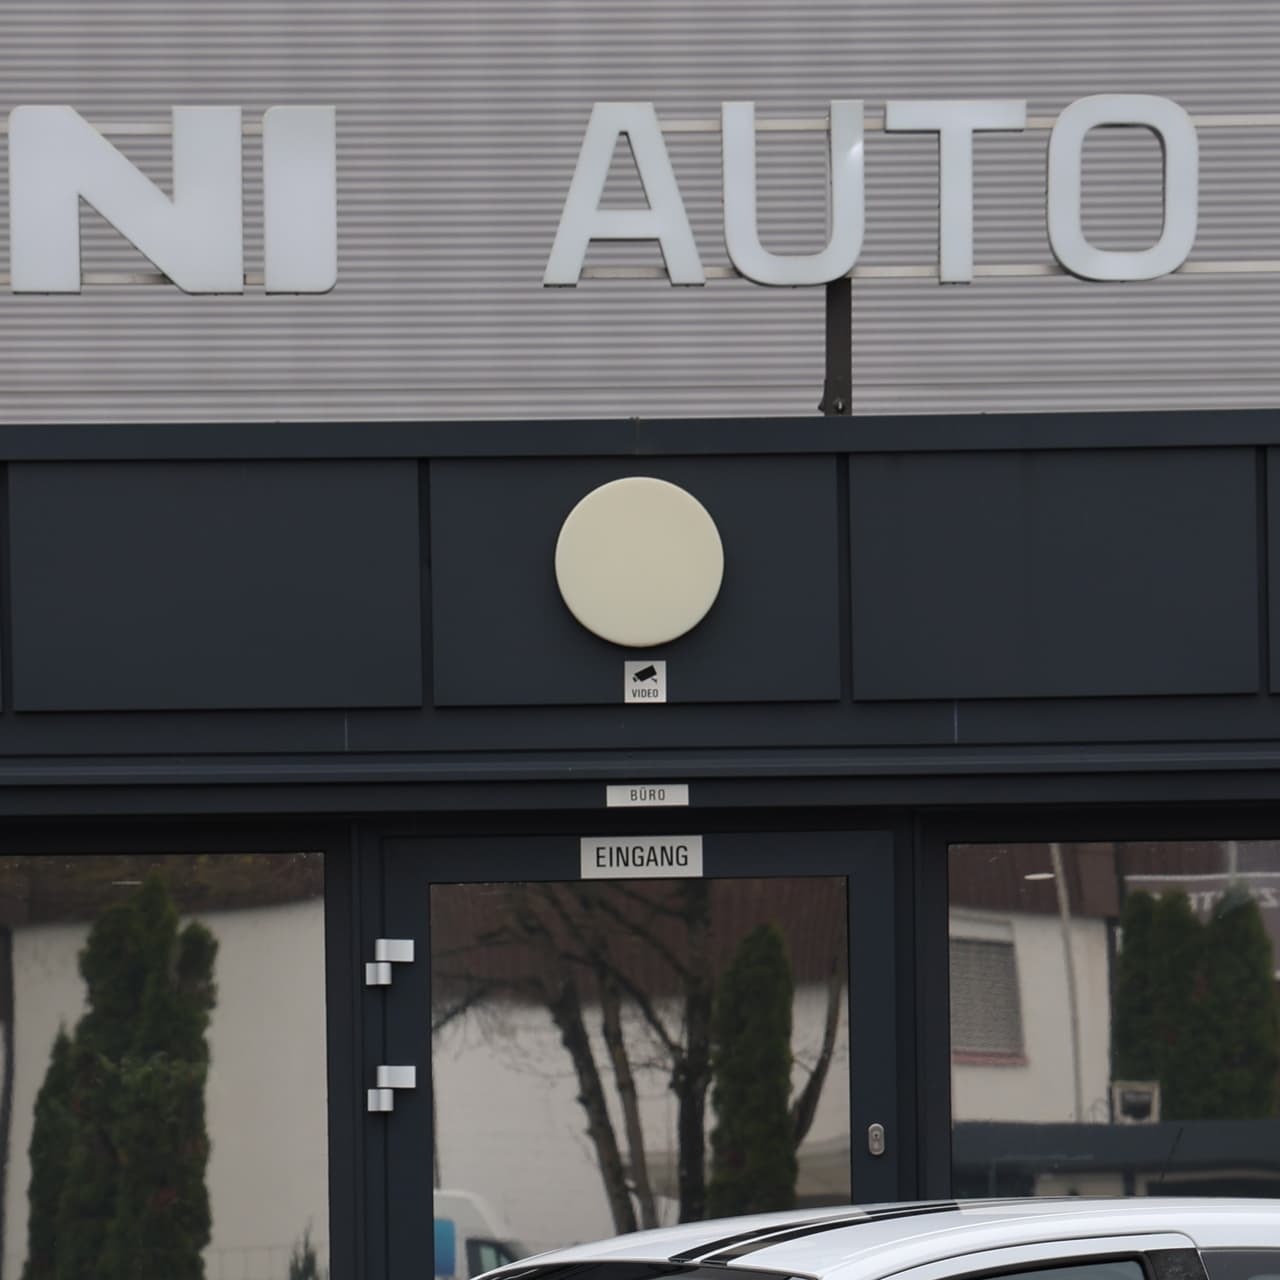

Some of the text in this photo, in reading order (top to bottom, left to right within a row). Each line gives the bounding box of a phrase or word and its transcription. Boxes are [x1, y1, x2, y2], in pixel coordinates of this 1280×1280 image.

[543, 92, 1199, 288] AUTO
[631, 688, 659, 699] VIDEO
[629, 787, 666, 801] BÜRO
[595, 845, 689, 868] EINGANG
